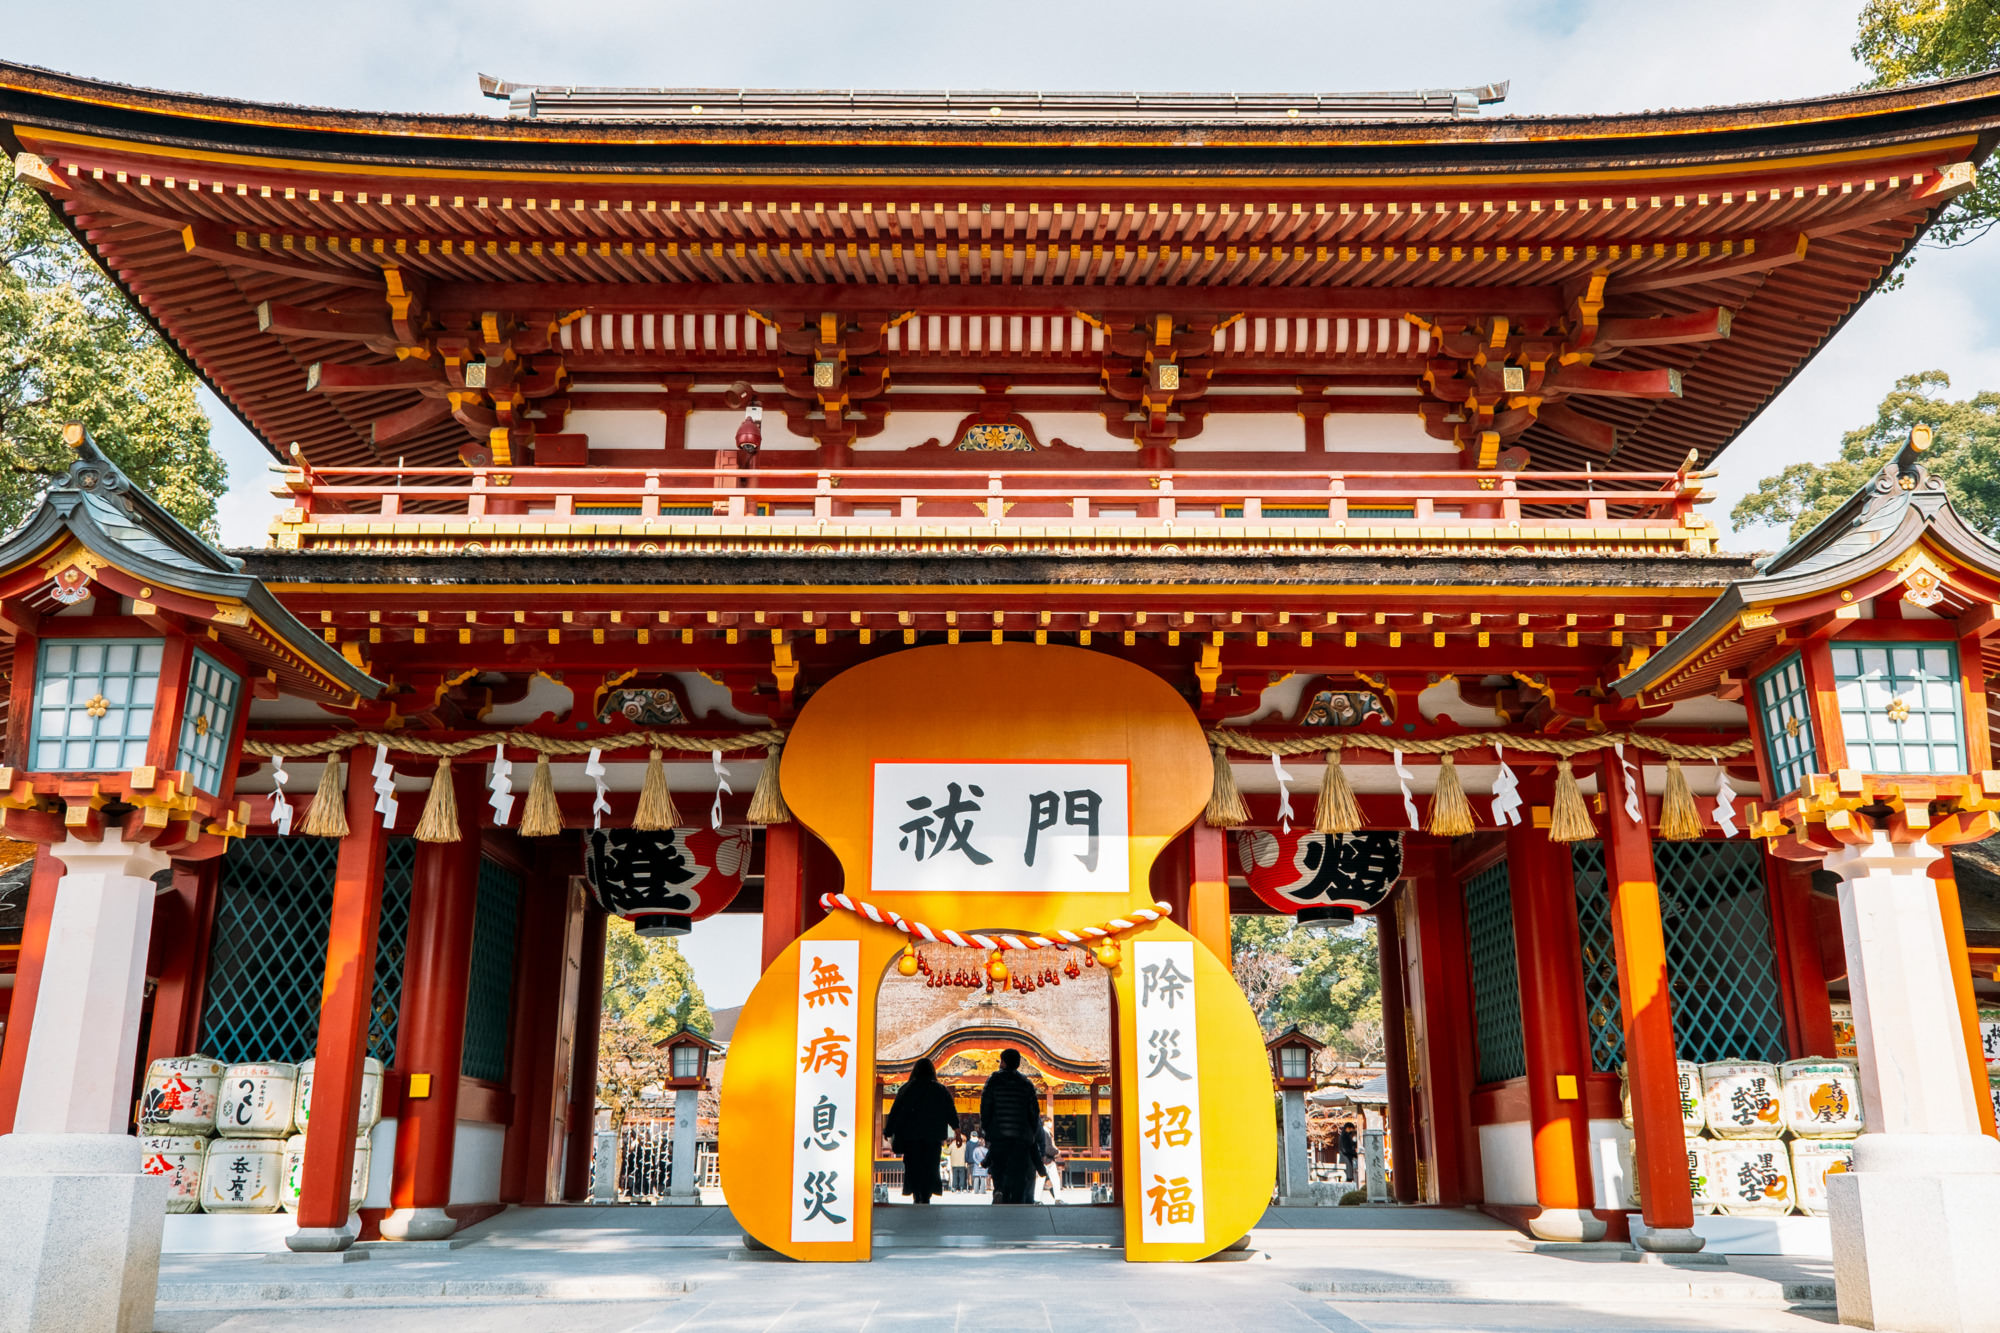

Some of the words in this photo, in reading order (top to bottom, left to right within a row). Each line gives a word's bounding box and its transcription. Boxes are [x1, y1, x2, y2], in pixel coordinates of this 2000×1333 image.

[898, 781, 1104, 873] 祓門
[157, 1073, 193, 1111] 八鹿
[236, 1079, 255, 1126] つくし
[800, 956, 854, 1225] 無病息災
[1140, 957, 1197, 1226] 除災招福
